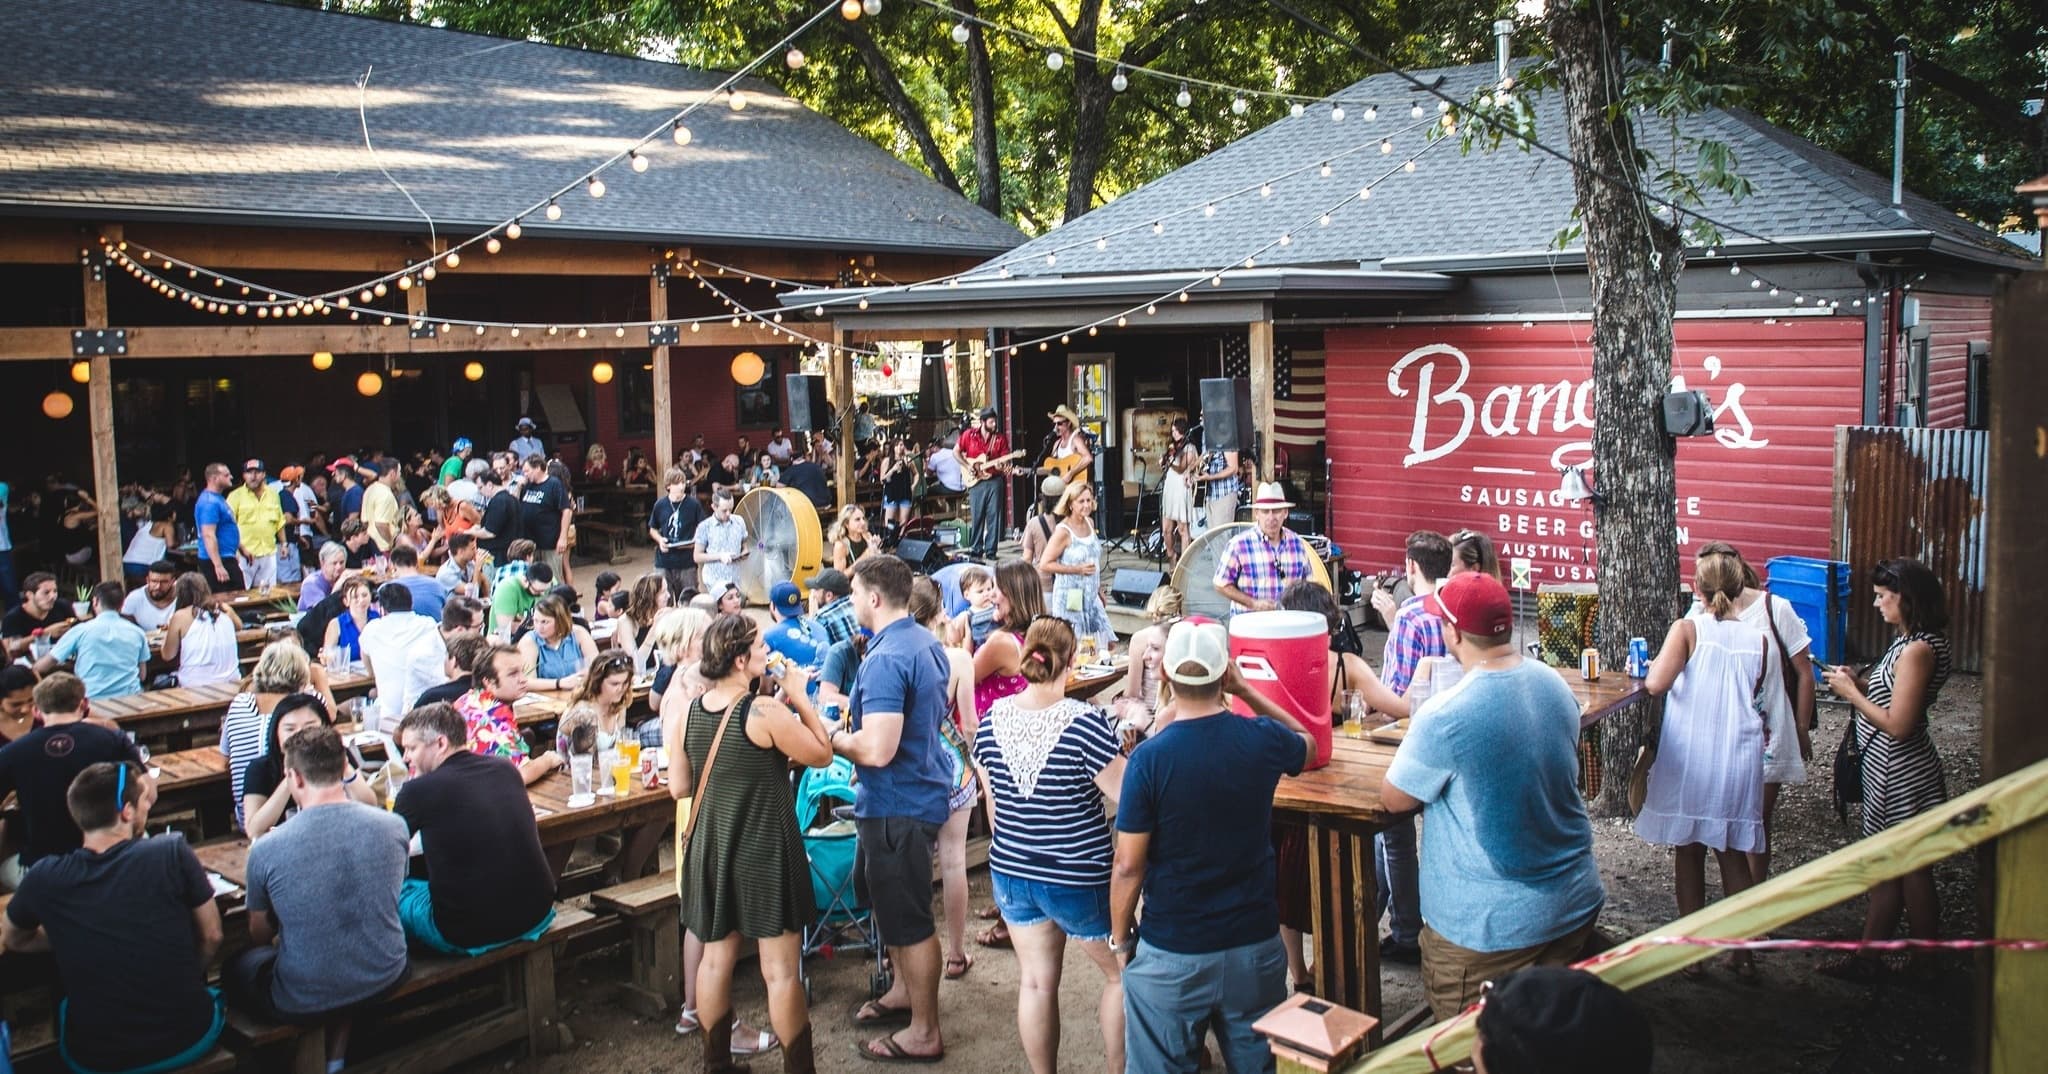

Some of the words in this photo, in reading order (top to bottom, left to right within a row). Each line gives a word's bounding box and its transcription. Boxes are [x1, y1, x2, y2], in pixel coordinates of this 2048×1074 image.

[1387, 343, 1769, 471] Bang's
[1499, 513, 1566, 537] BEER
[1555, 566, 1595, 580] USA
